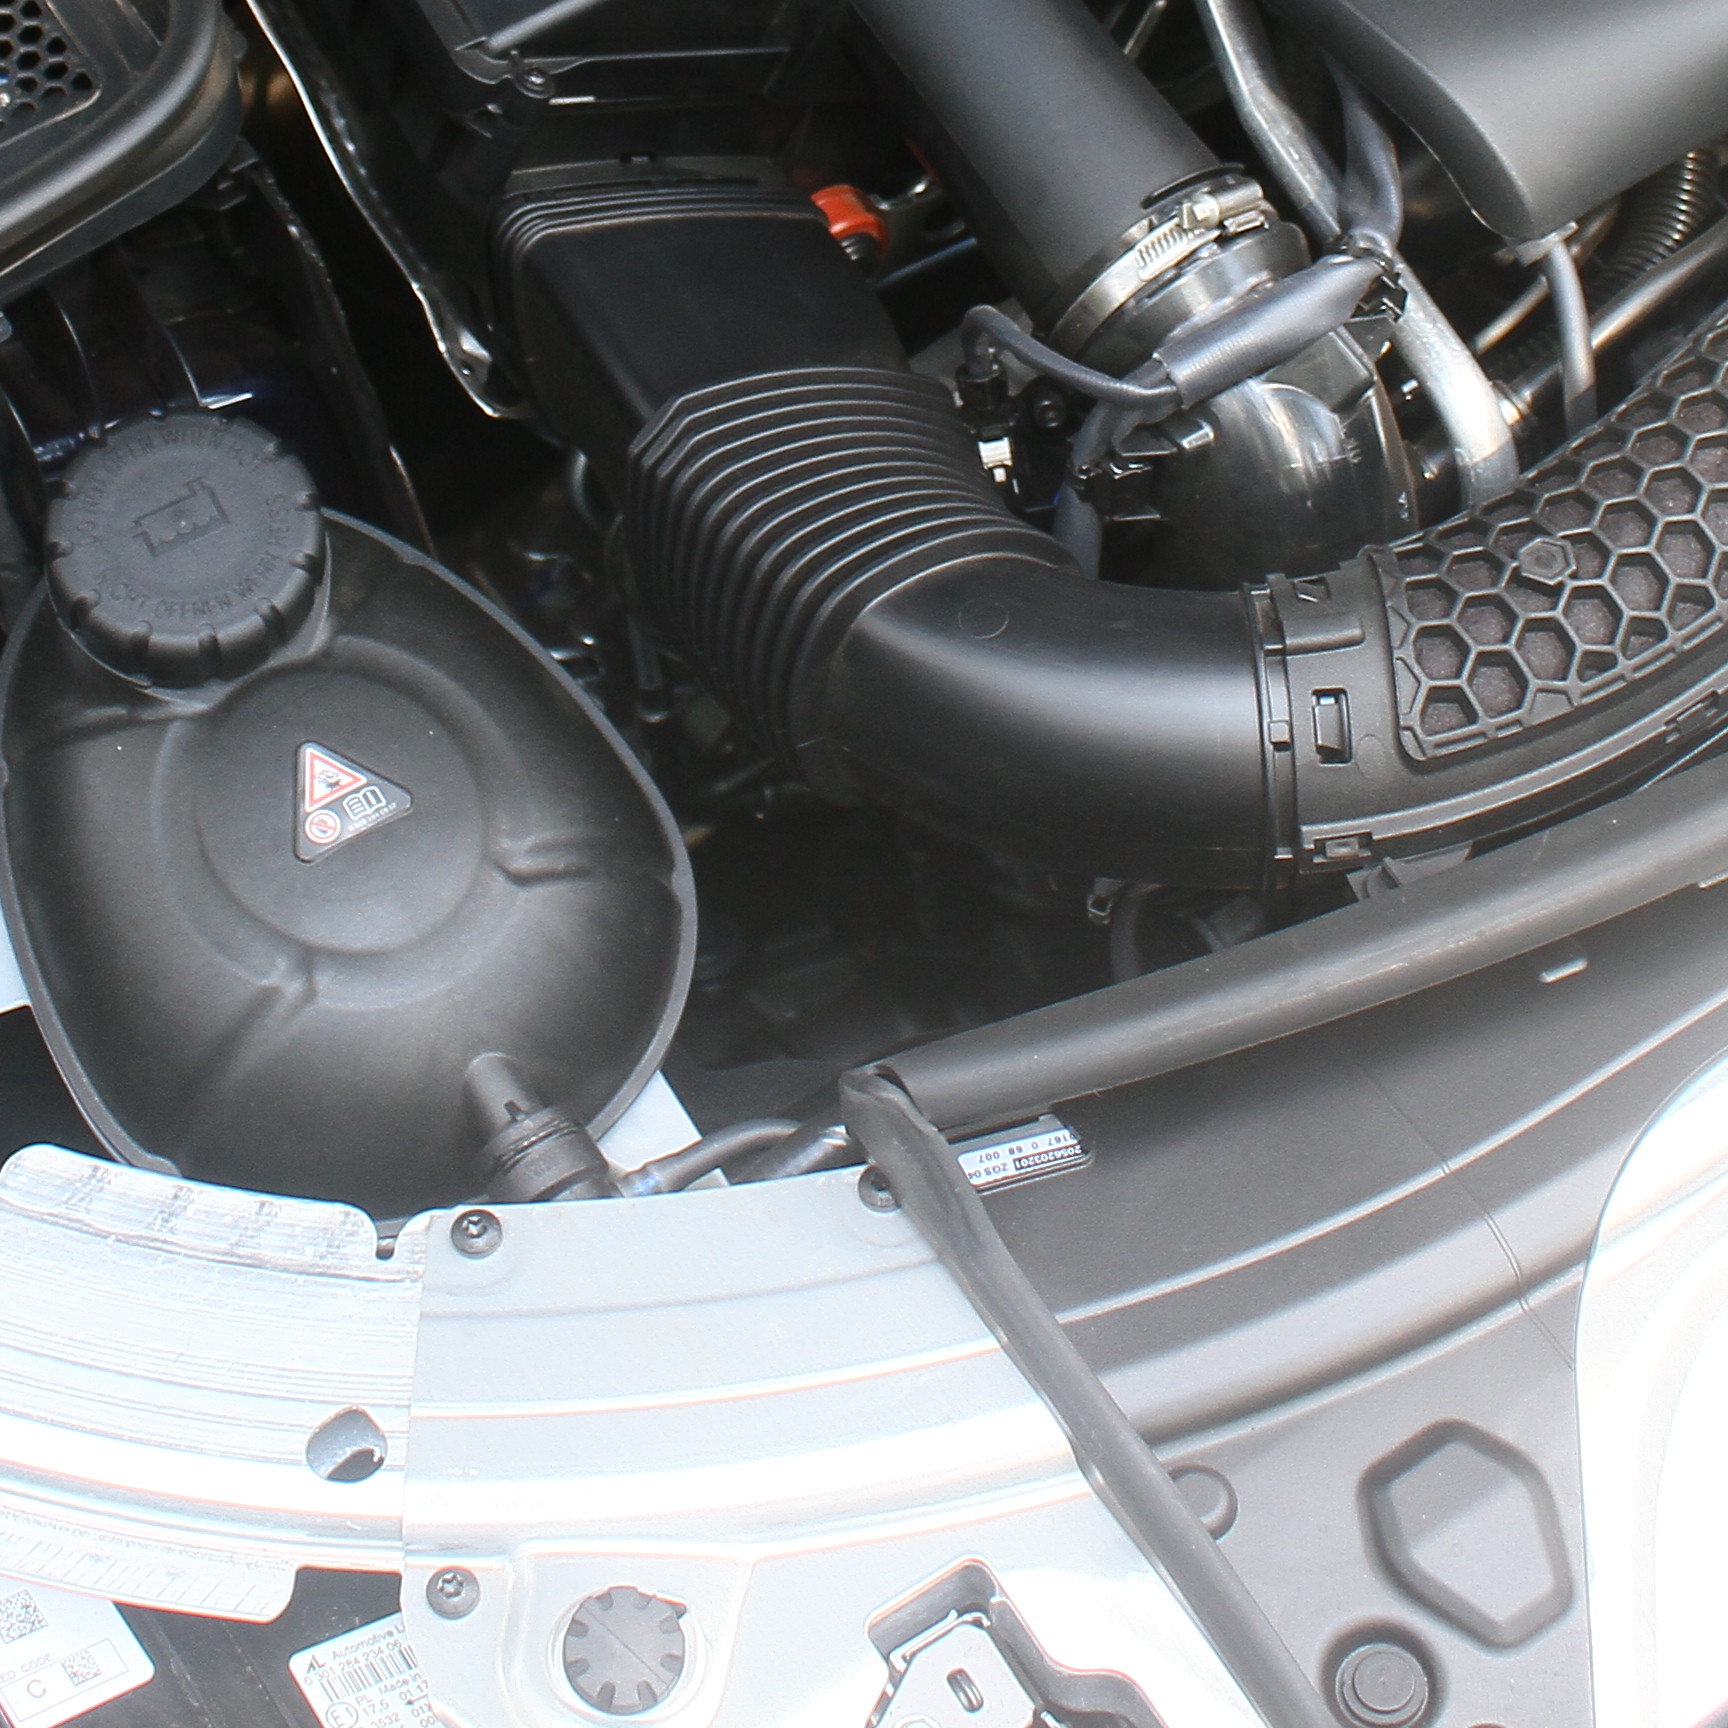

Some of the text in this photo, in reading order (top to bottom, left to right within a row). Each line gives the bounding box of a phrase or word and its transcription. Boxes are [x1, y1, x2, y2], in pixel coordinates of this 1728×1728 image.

[333, 1630, 394, 1660] Automotive
[21, 1652, 55, 1673] CODE
[315, 1666, 336, 1682] 301
[339, 1656, 361, 1672] 284
[362, 1646, 385, 1662] 234
[27, 1679, 46, 1698] C
[355, 1694, 374, 1707] PL
[378, 1678, 410, 1695] Made
[362, 1698, 390, 1717] 17,5
